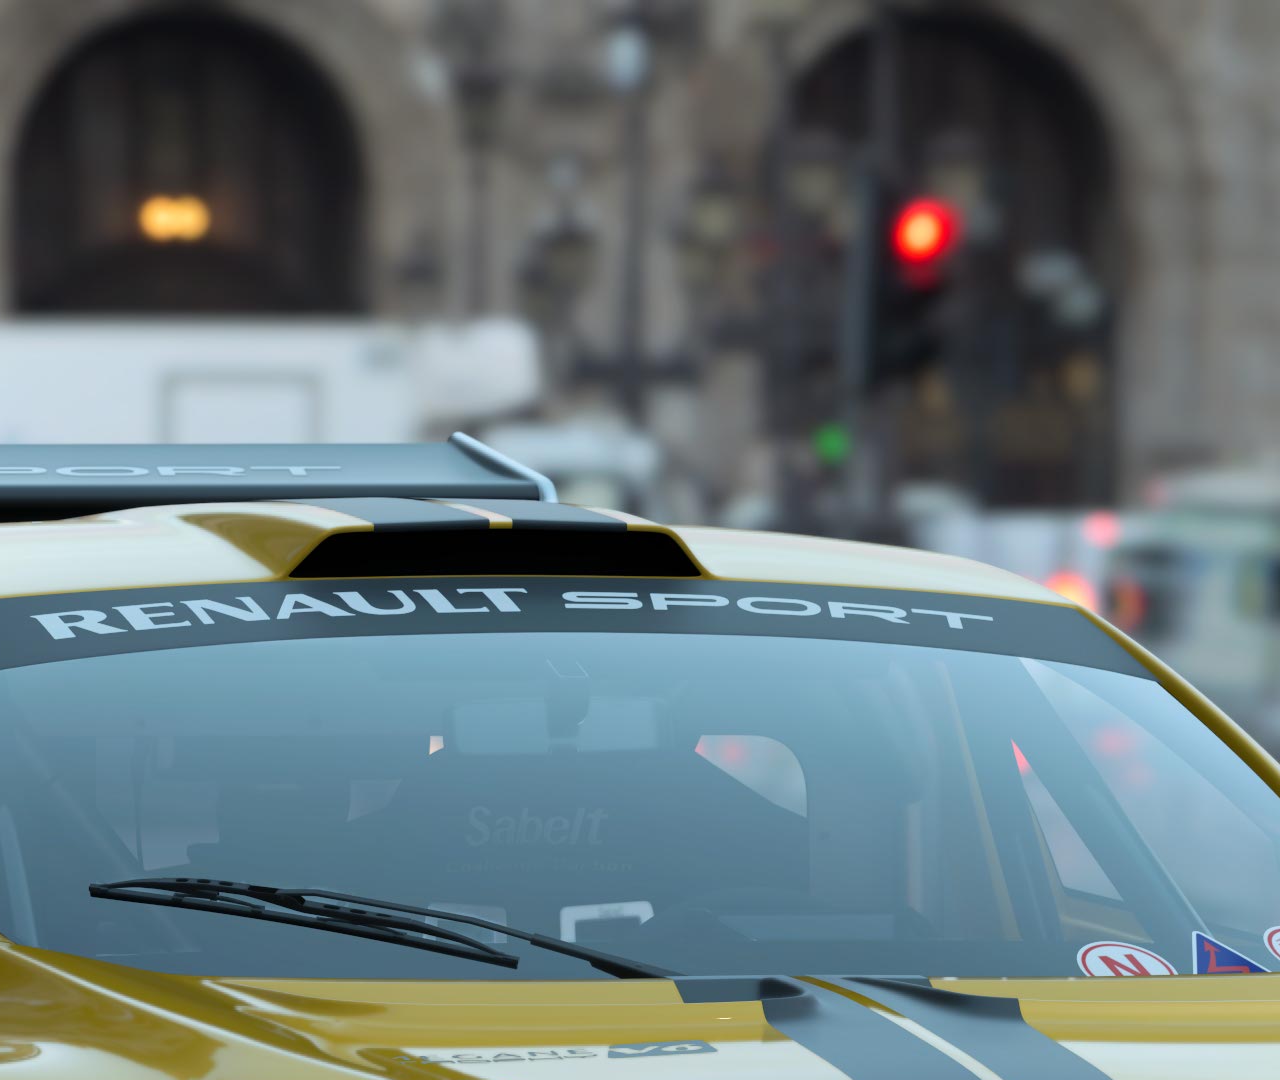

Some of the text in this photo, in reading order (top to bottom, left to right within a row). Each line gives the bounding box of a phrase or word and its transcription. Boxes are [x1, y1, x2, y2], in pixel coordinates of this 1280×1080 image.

[30, 587, 994, 640] RENAULT SPORT
[464, 804, 609, 847] Sabelt
[1097, 953, 1152, 977] N
